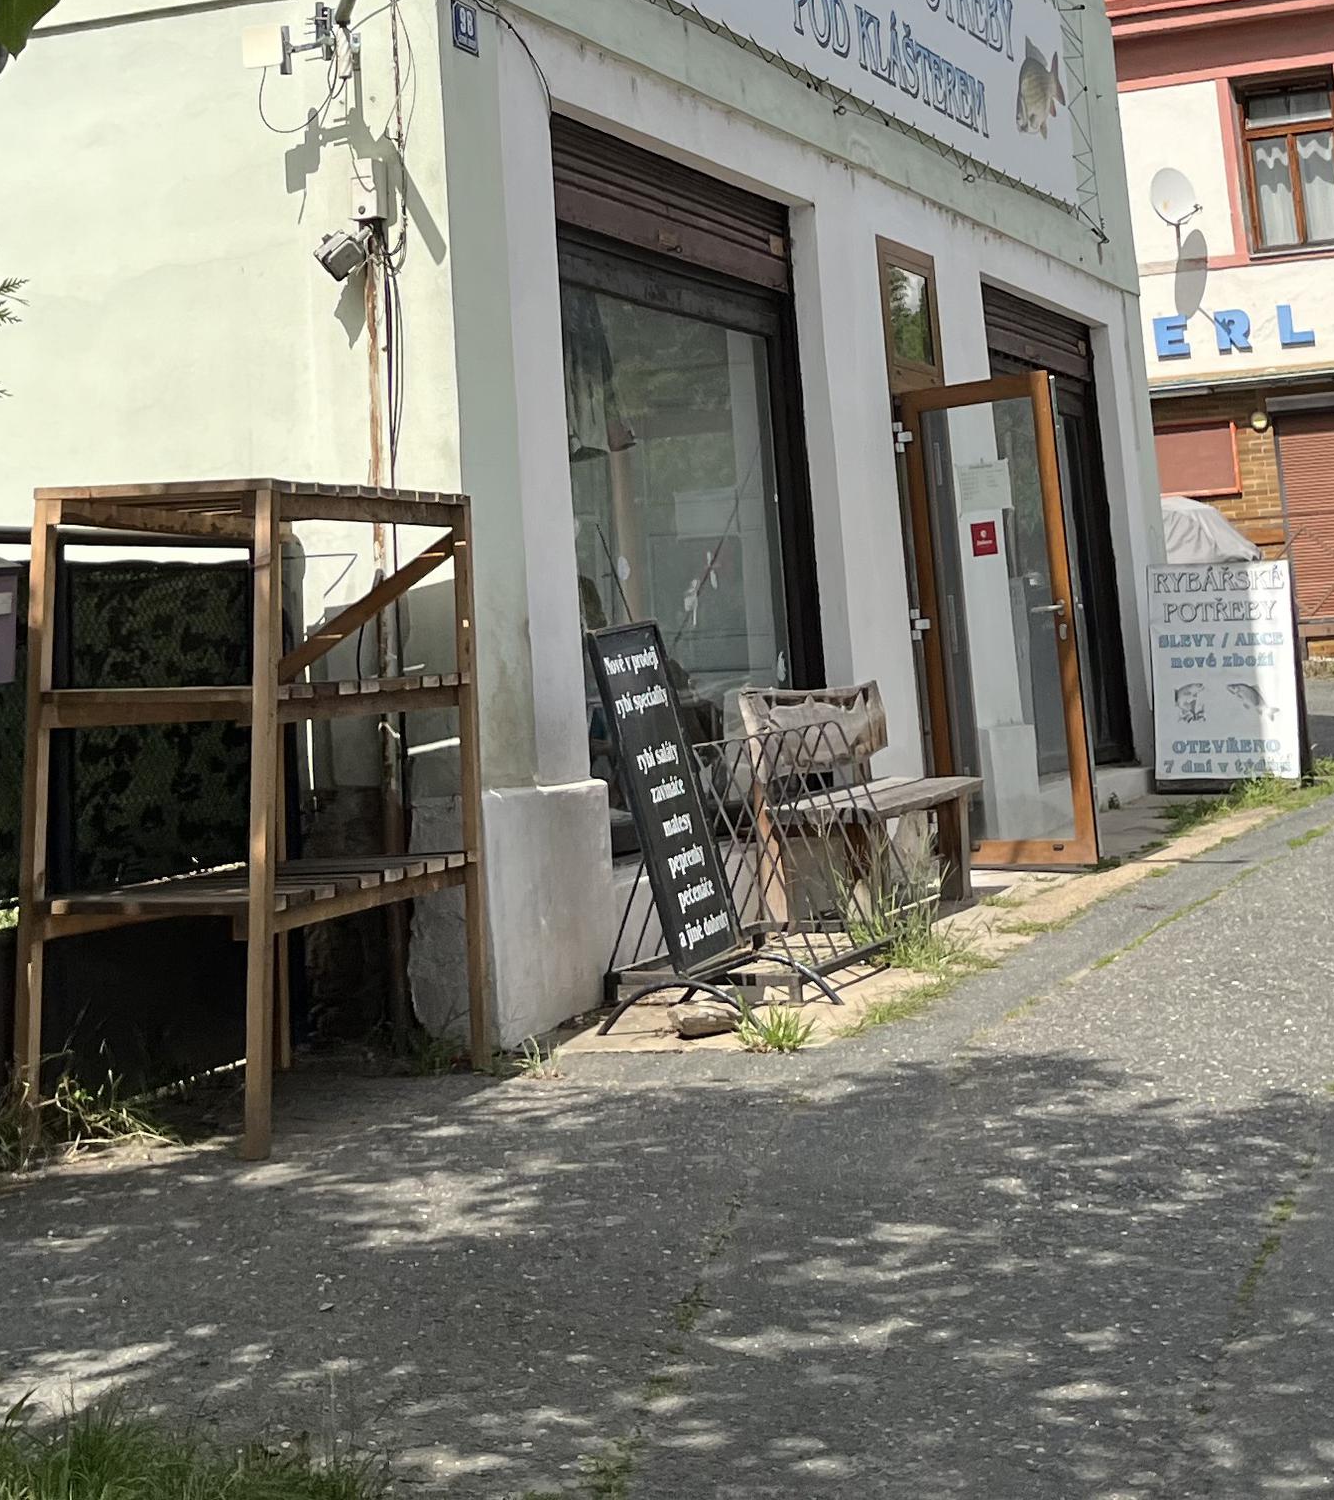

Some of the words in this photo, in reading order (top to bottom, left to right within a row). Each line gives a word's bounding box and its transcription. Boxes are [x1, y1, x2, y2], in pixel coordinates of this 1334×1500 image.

[460, 7, 474, 37] 98
[854, 9, 989, 139] KLÁŠTEREM
[1153, 565, 1285, 593] RYBÁŘSKÉ
[1163, 597, 1277, 623] POTŘEBY
[1158, 633, 1215, 648] SLEVY
[1235, 631, 1284, 646] AKCE
[1170, 652, 1217, 668] nové
[1172, 737, 1281, 754] OTEVŘENO
[1164, 760, 1174, 773] 7
[1181, 758, 1213, 773] dní
[1217, 762, 1229, 773] v
[679, 932, 687, 947] a
